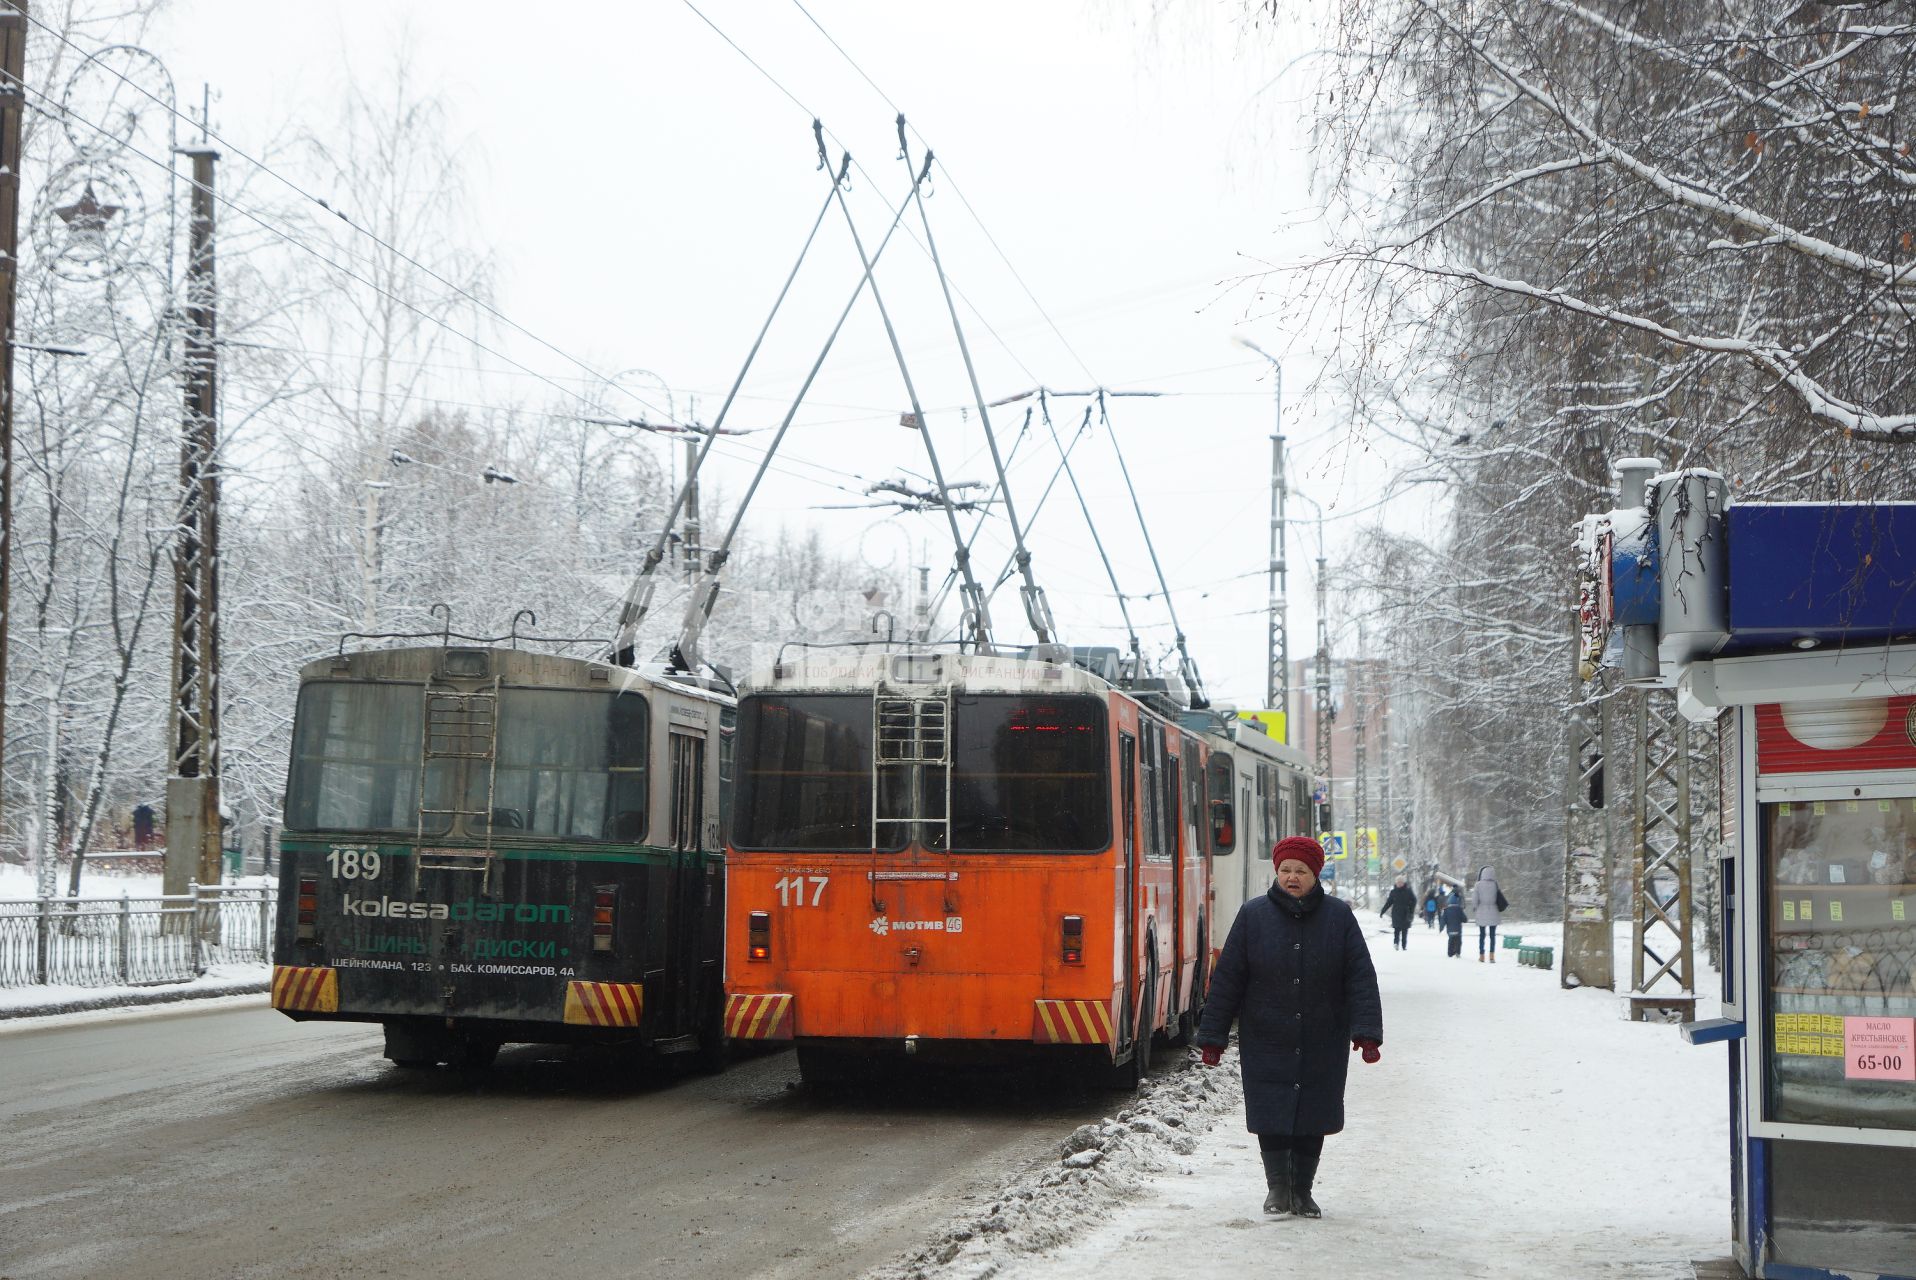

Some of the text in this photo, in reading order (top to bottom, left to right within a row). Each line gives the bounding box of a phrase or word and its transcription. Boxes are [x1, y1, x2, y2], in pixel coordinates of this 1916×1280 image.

[326, 849, 381, 881] 189
[775, 876, 829, 907] 117
[946, 918, 962, 932] 4G
[475, 938, 556, 960] ДИСКИ
[331, 957, 405, 972] ШЕЙНКМАНА,
[411, 961, 432, 972] 123
[451, 963, 476, 974] БАК.
[478, 964, 558, 977] КОМИССАРОВ,
[1866, 1022, 1891, 1031] МАСЛО
[1852, 1033, 1908, 1043] КРЕСТЬЯНСКОЕ
[1858, 1055, 1902, 1071] 65-00
